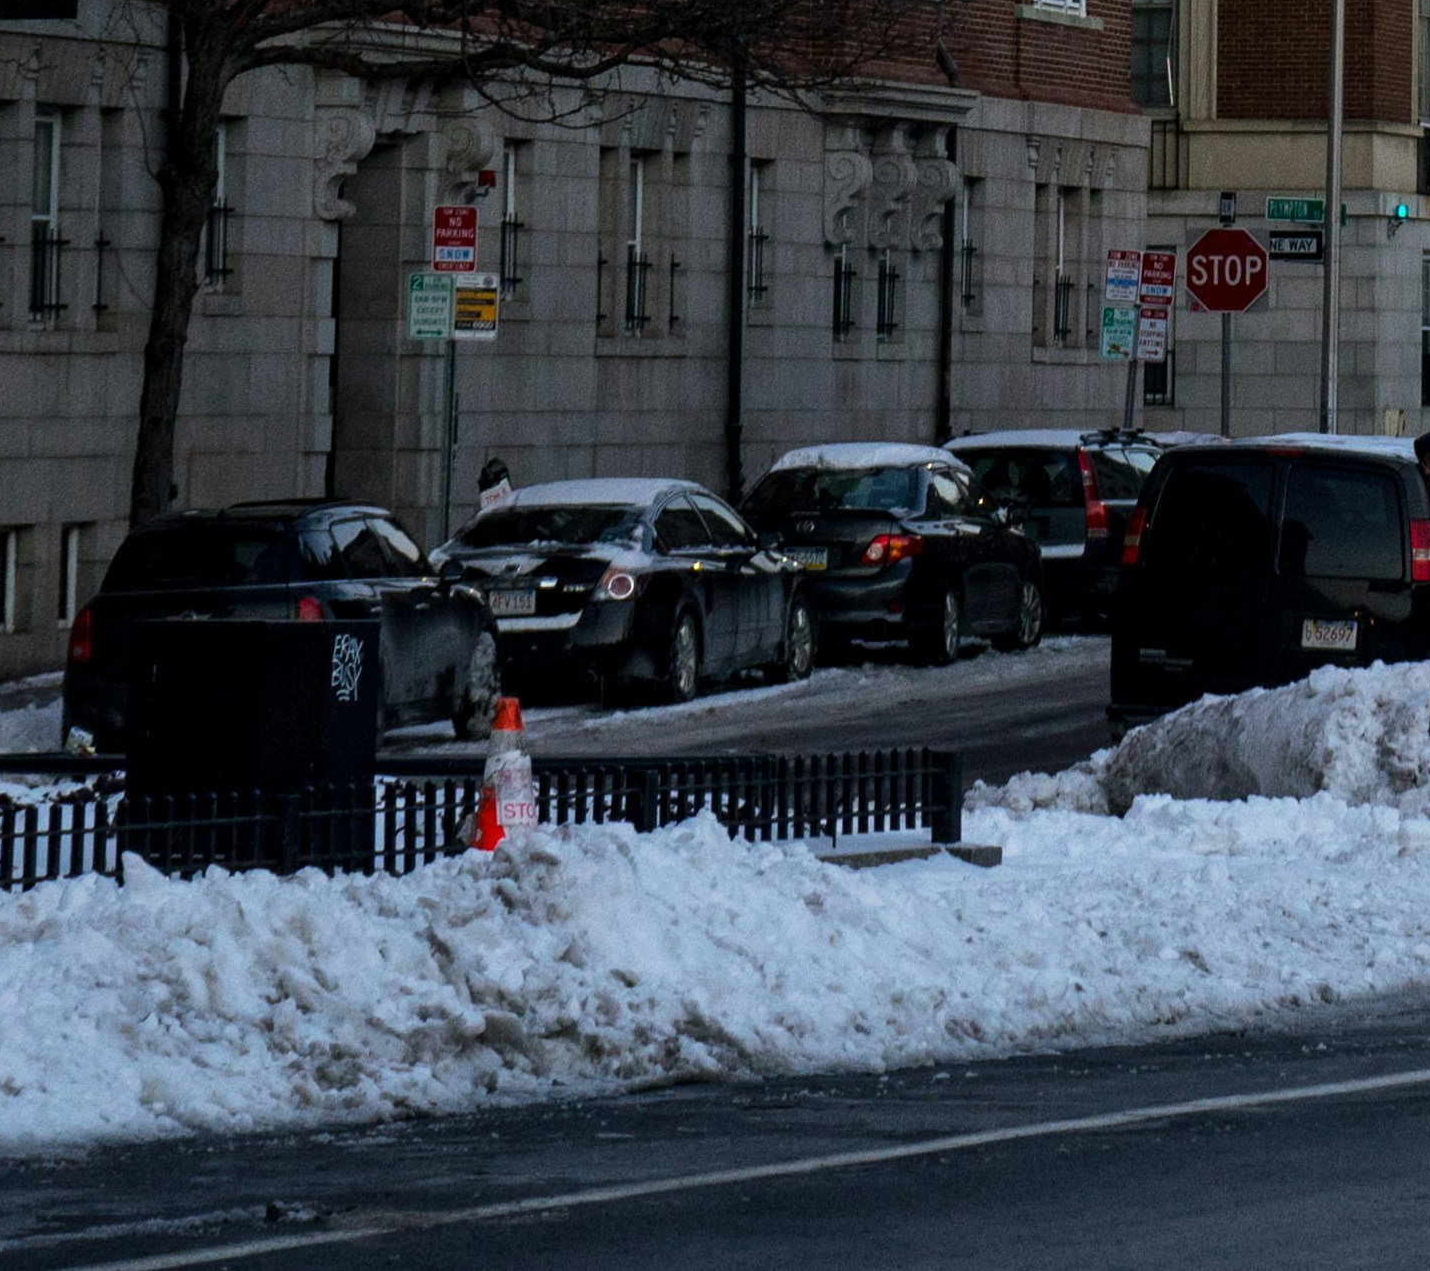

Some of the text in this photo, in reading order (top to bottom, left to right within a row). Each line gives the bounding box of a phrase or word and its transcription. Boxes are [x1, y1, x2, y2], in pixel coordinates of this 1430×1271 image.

[1270, 200, 1309, 217] PLYMPTON
[449, 217, 463, 227] NO
[436, 227, 474, 238] PARKING
[1270, 239, 1313, 252] NE WAY
[439, 249, 469, 259] SNOW
[1190, 255, 1263, 287] STOP
[413, 277, 423, 290] 2
[1145, 285, 1168, 296] SNOW
[1105, 310, 1113, 324] 2
